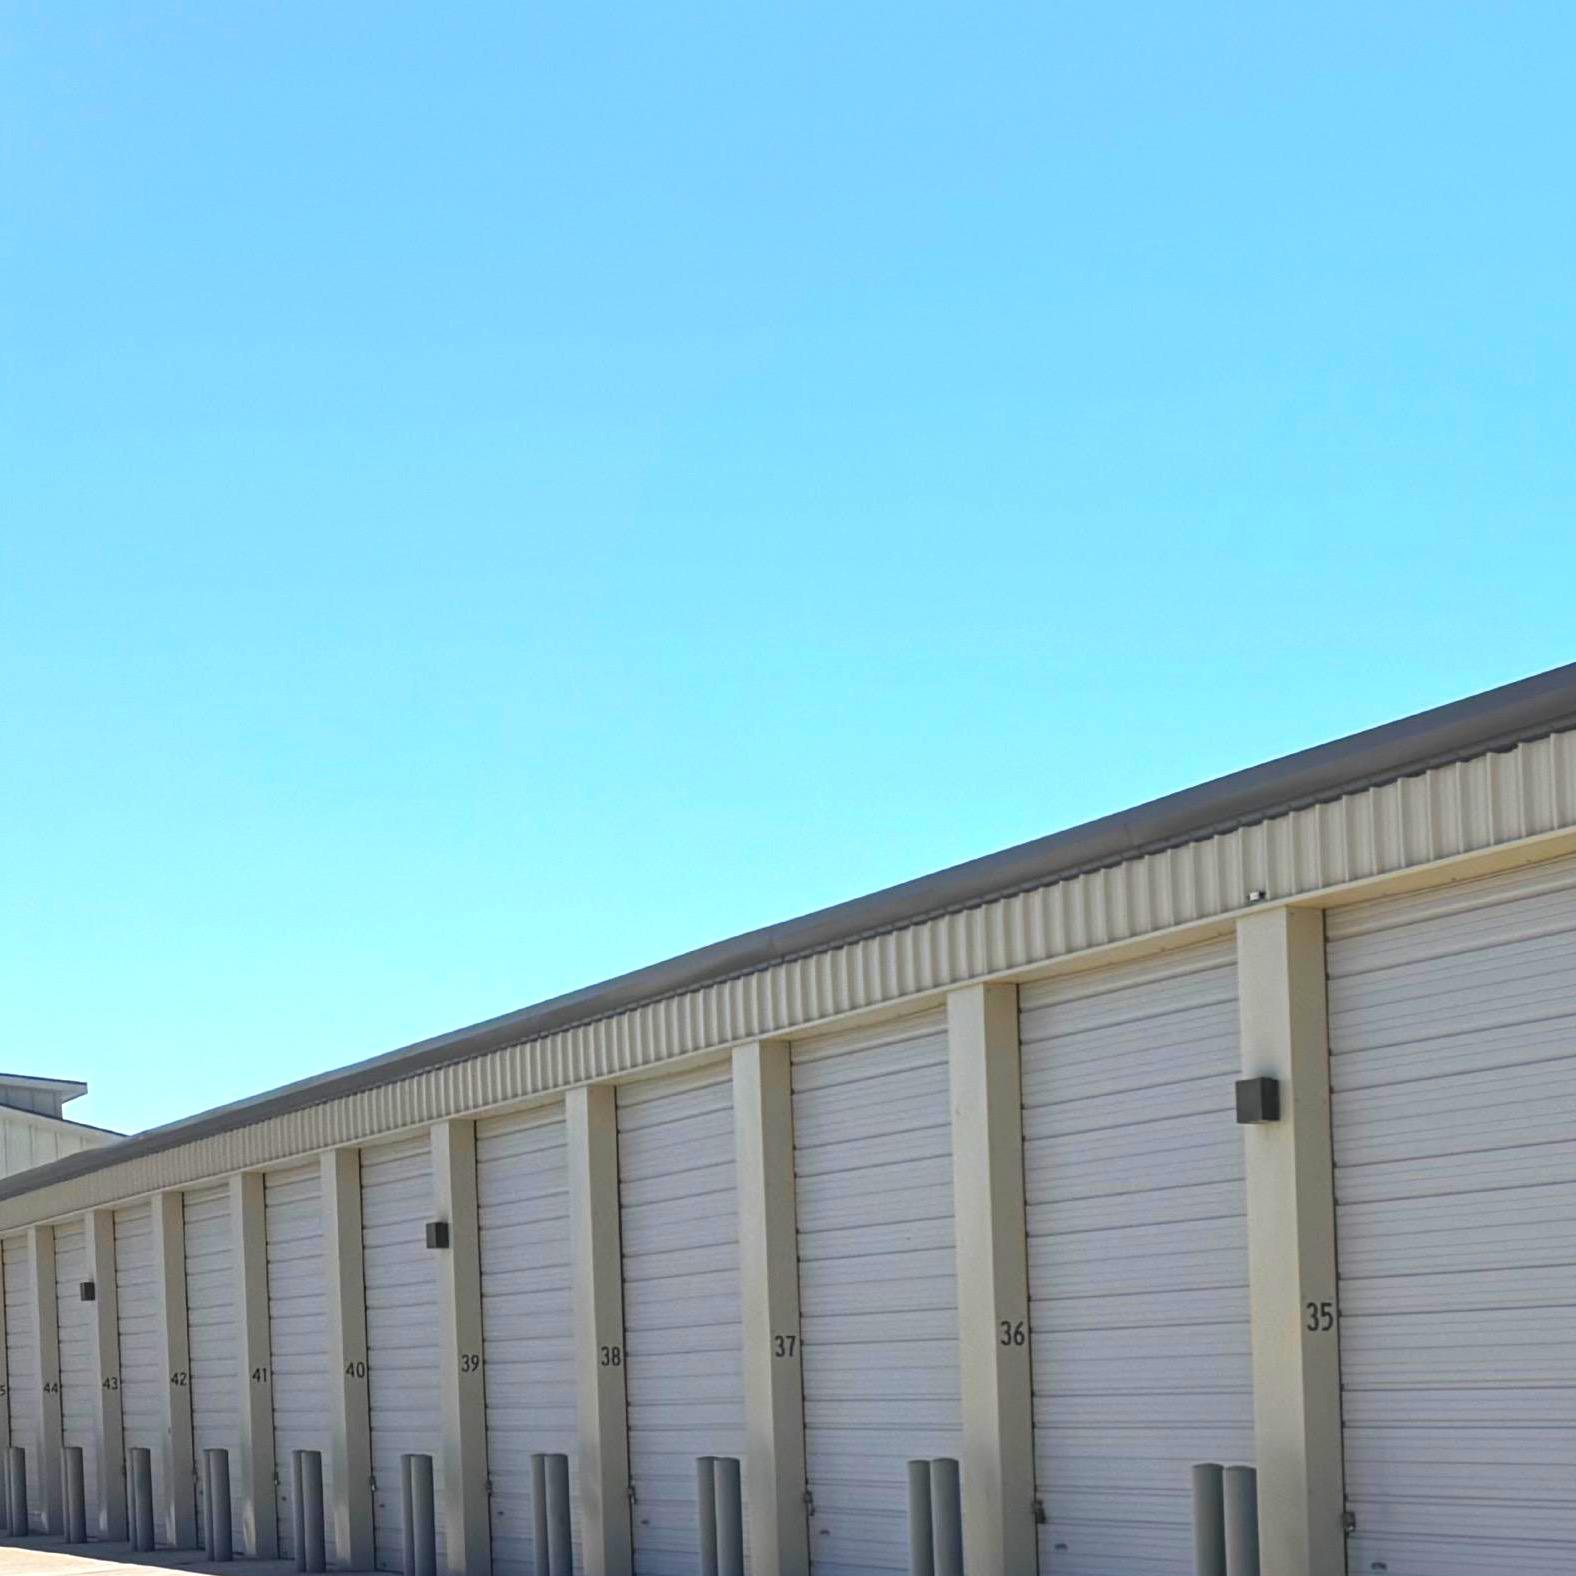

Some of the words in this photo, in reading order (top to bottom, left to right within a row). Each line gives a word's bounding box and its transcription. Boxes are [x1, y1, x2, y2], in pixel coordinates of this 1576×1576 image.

[1306, 1302, 1333, 1332] 35
[1000, 1321, 1026, 1347] 36
[600, 1345, 622, 1367] 38
[775, 1335, 797, 1359] 37
[345, 1361, 366, 1379] 40
[461, 1353, 481, 1373] 39
[102, 1377, 119, 1391] 43
[171, 1372, 188, 1386] 42
[252, 1366, 269, 1383] 41
[43, 1383, 59, 1396] 44
